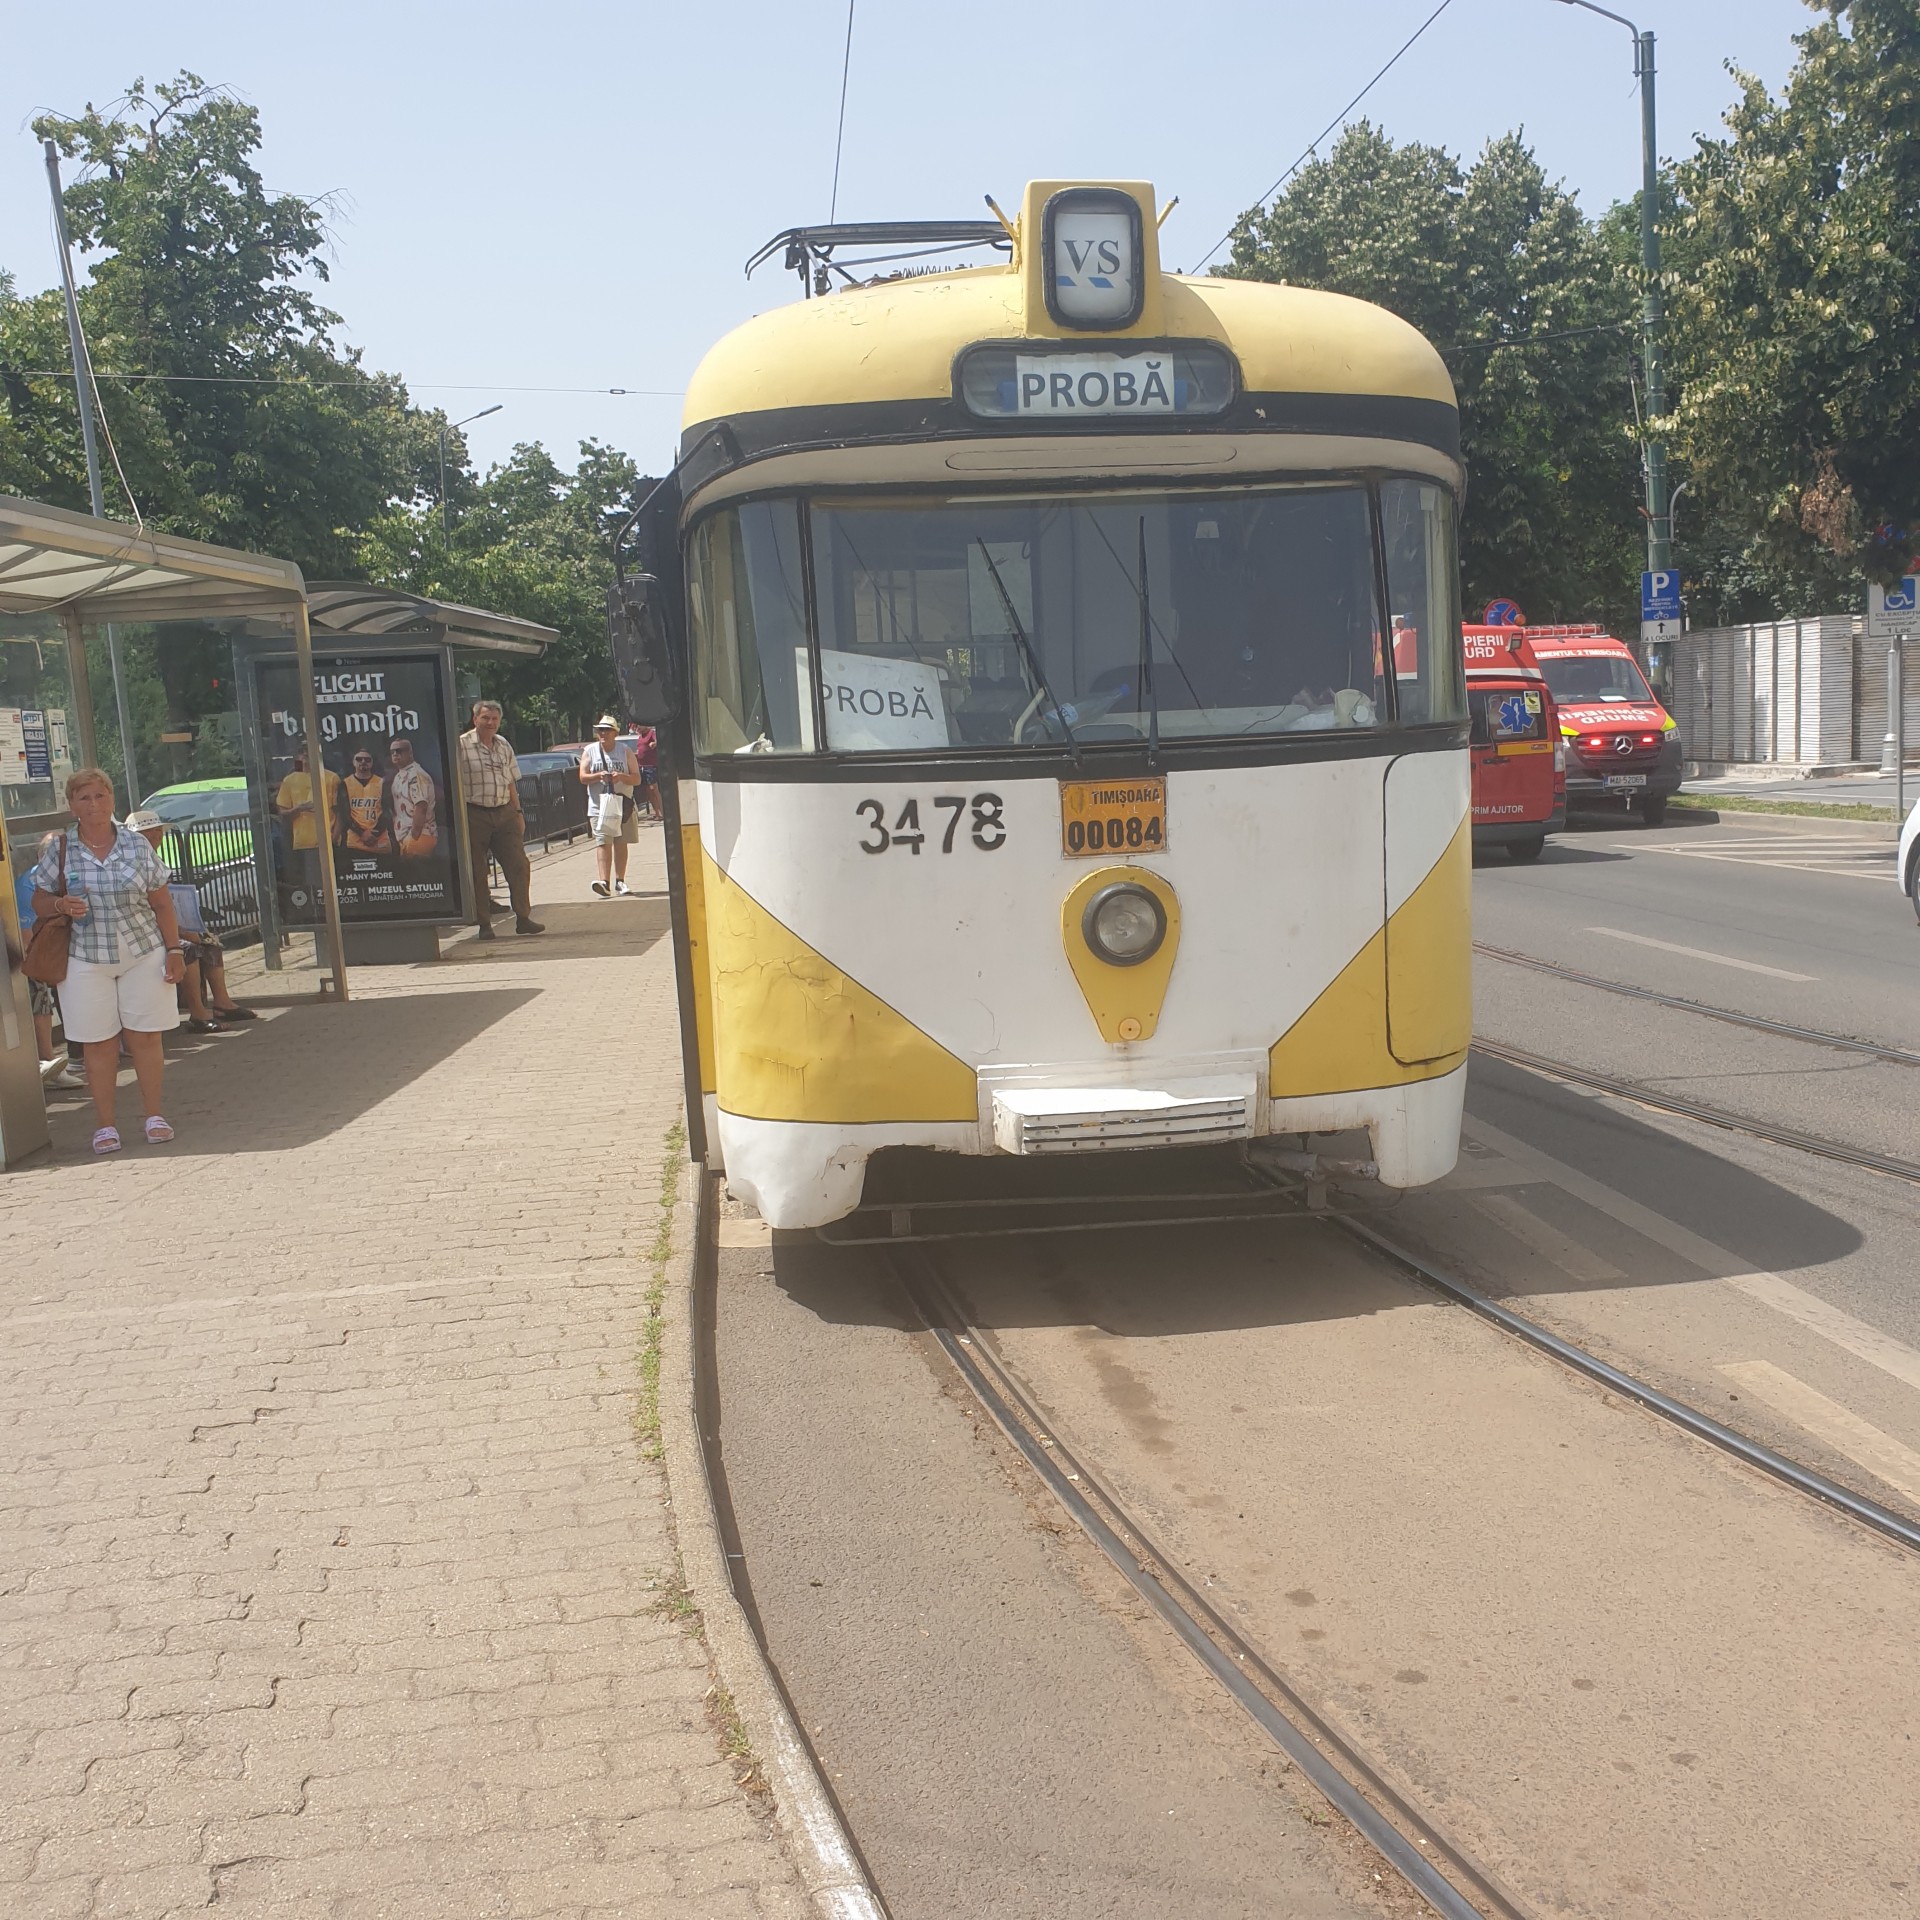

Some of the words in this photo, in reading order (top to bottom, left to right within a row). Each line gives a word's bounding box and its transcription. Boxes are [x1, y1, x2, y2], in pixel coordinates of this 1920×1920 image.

[1062, 239, 1120, 274] VS
[1022, 361, 1170, 408] PROBĂ
[1651, 572, 1670, 597] P
[822, 683, 934, 720] PROBĂ
[345, 705, 419, 738] mafia
[1092, 788, 1160, 808] TIMIȘOARA
[1471, 806, 1489, 815] PRIM
[1491, 805, 1524, 814] AJUTOR
[856, 792, 1007, 855] 3478
[1068, 817, 1163, 852] 00084
[346, 873, 368, 881] MANY
[370, 872, 394, 880] MORE
[368, 885, 404, 895] MUZEUL
[405, 883, 444, 892] SATULUI
[339, 896, 359, 904] 2024
